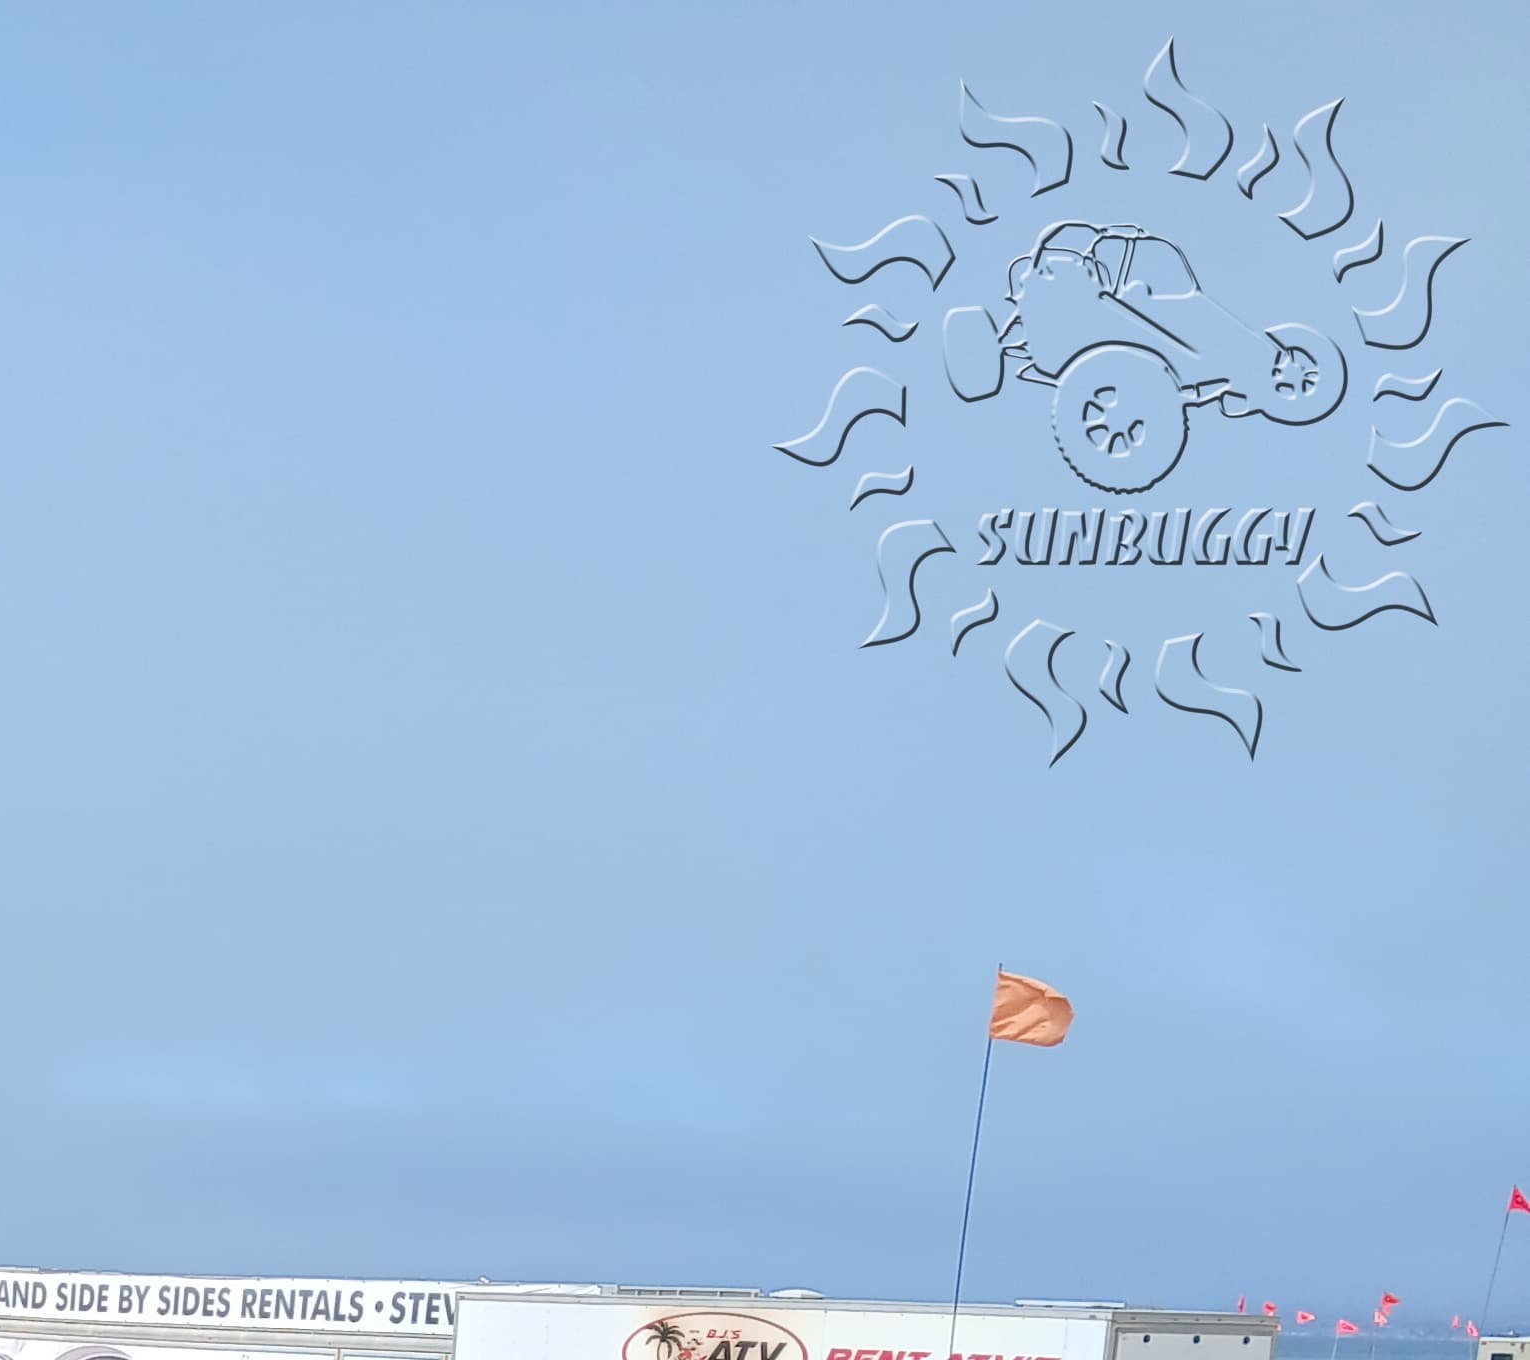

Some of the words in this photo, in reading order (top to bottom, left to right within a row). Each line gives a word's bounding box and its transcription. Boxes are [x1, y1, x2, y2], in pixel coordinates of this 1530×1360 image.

[55, 1282, 110, 1313] SIDE
[118, 1284, 151, 1315] BY
[157, 1285, 231, 1319] SIDES
[241, 1288, 364, 1323] RENTALS
